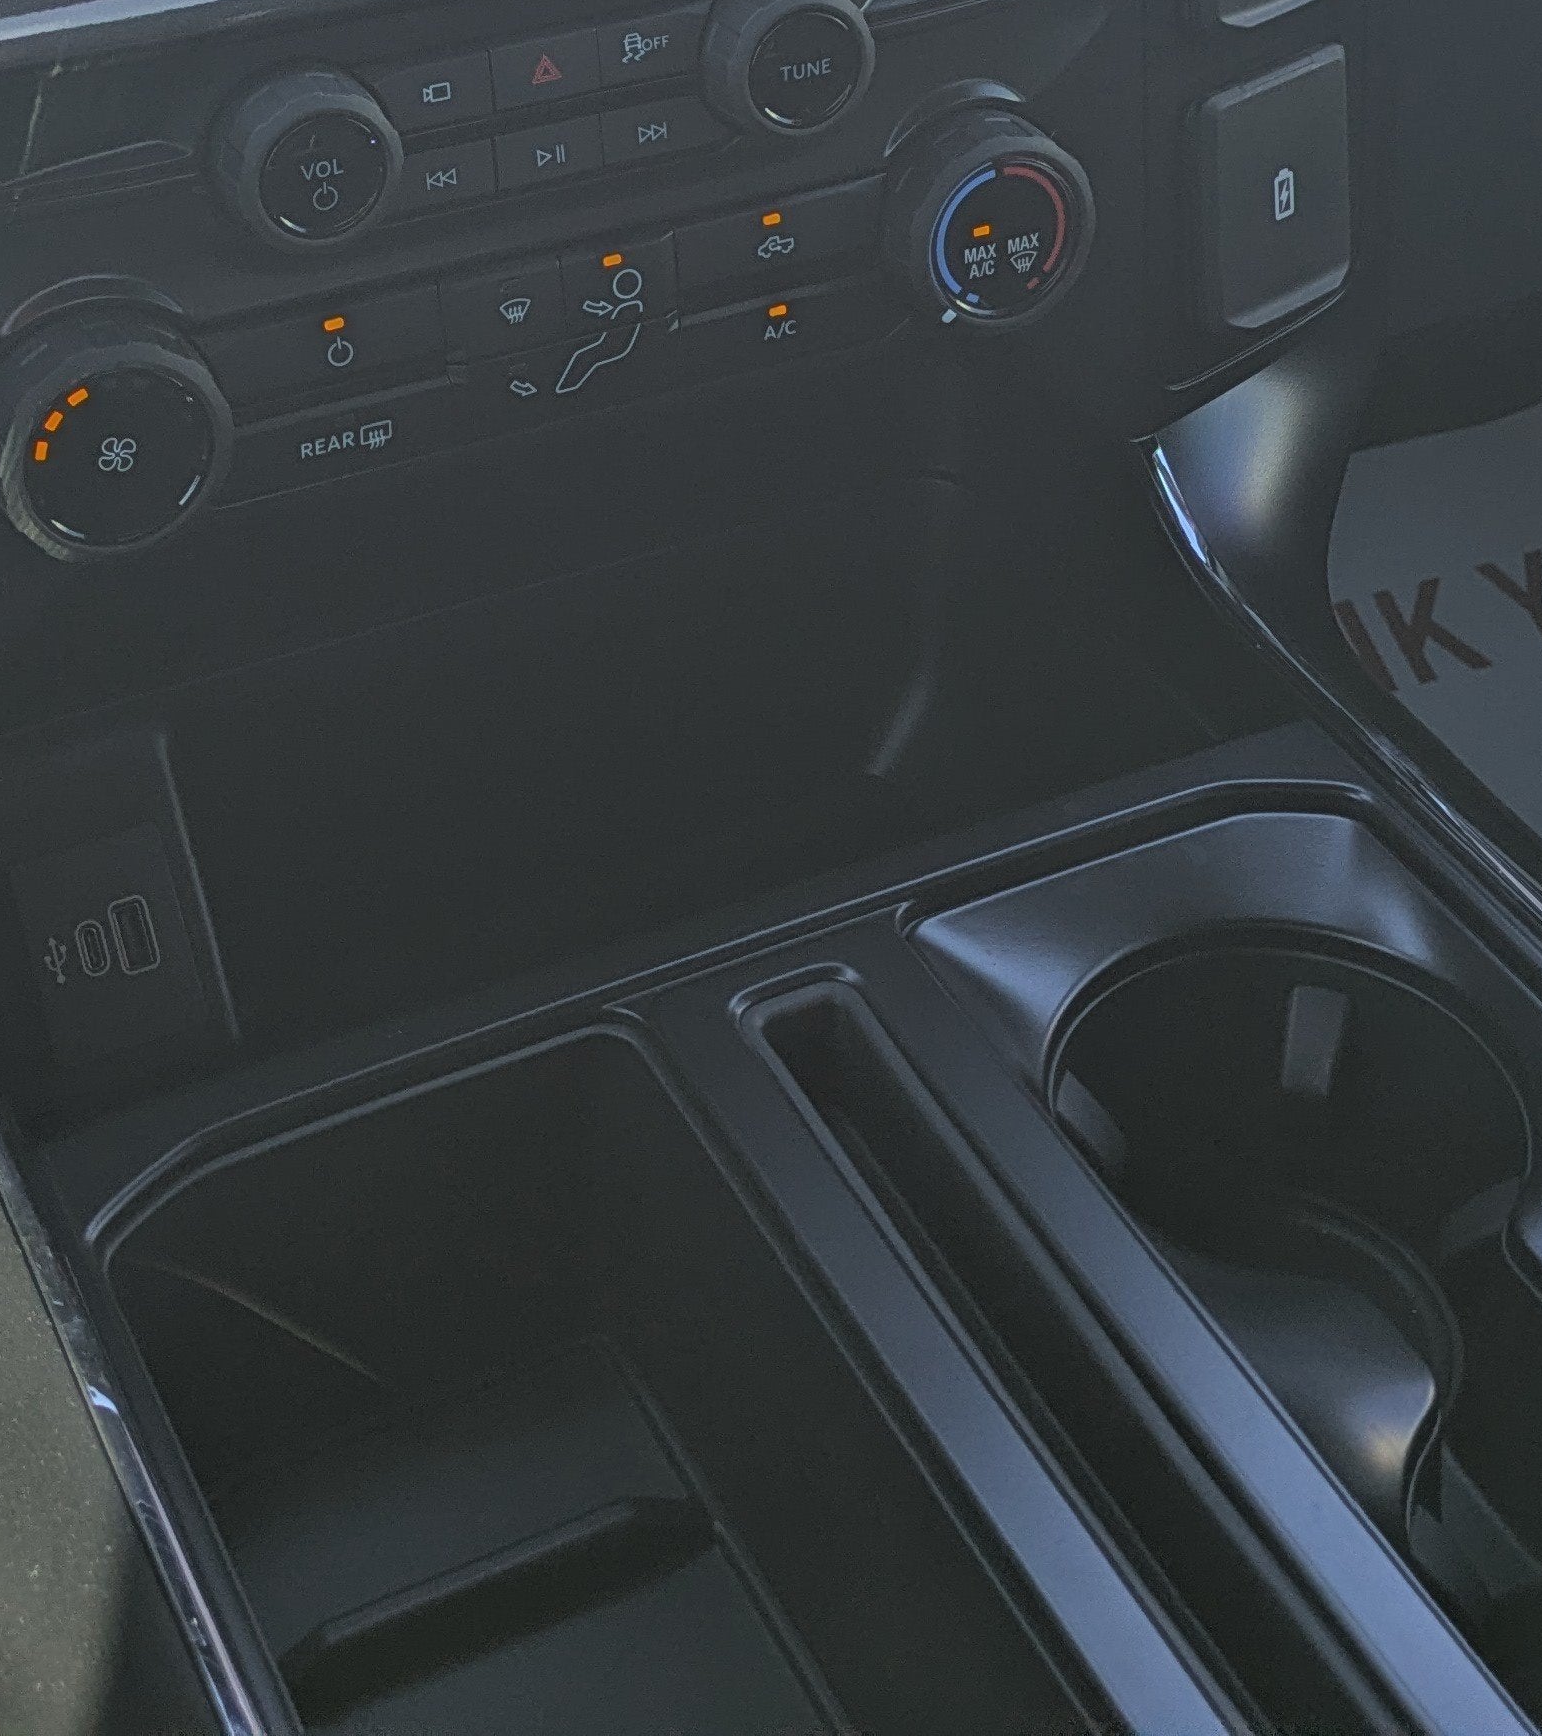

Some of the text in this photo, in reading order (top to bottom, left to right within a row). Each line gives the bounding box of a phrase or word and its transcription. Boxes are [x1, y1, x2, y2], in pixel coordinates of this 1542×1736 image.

[641, 34, 670, 53] OFF
[779, 57, 832, 82] TUNE
[300, 158, 345, 181] VOL
[964, 244, 997, 264] MAX
[1007, 232, 1039, 255] MAX
[968, 260, 995, 280] A/C
[763, 319, 797, 341] A/C
[300, 431, 355, 459] REAR
